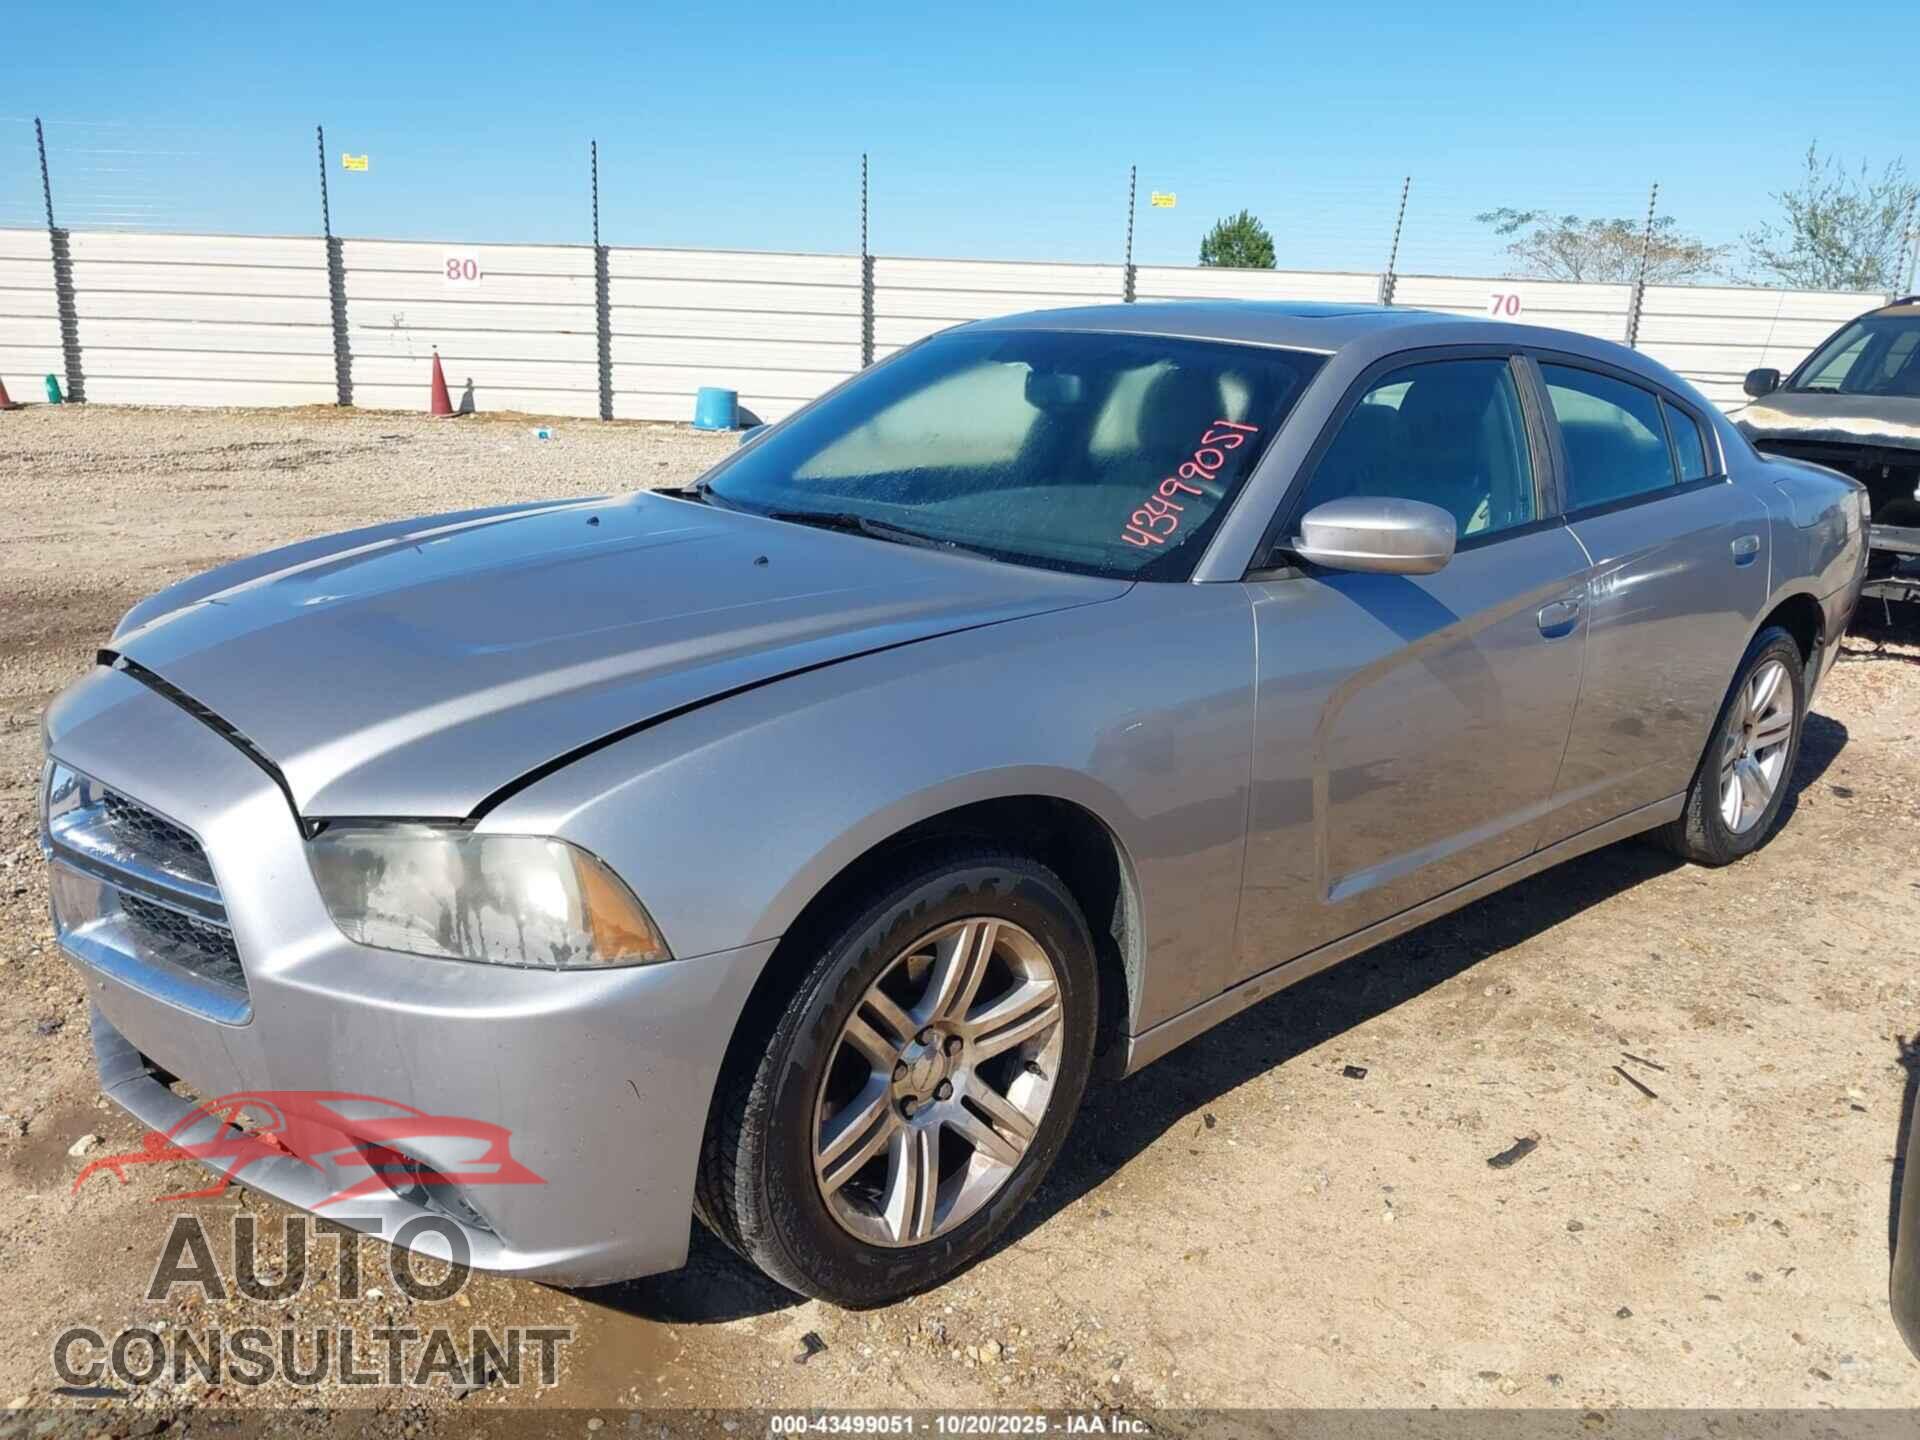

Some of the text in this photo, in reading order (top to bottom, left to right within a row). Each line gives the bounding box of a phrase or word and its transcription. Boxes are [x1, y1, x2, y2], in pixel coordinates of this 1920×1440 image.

[446, 258, 477, 281] 80
[1490, 294, 1520, 316] 70
[1120, 419, 1259, 547] 43499051
